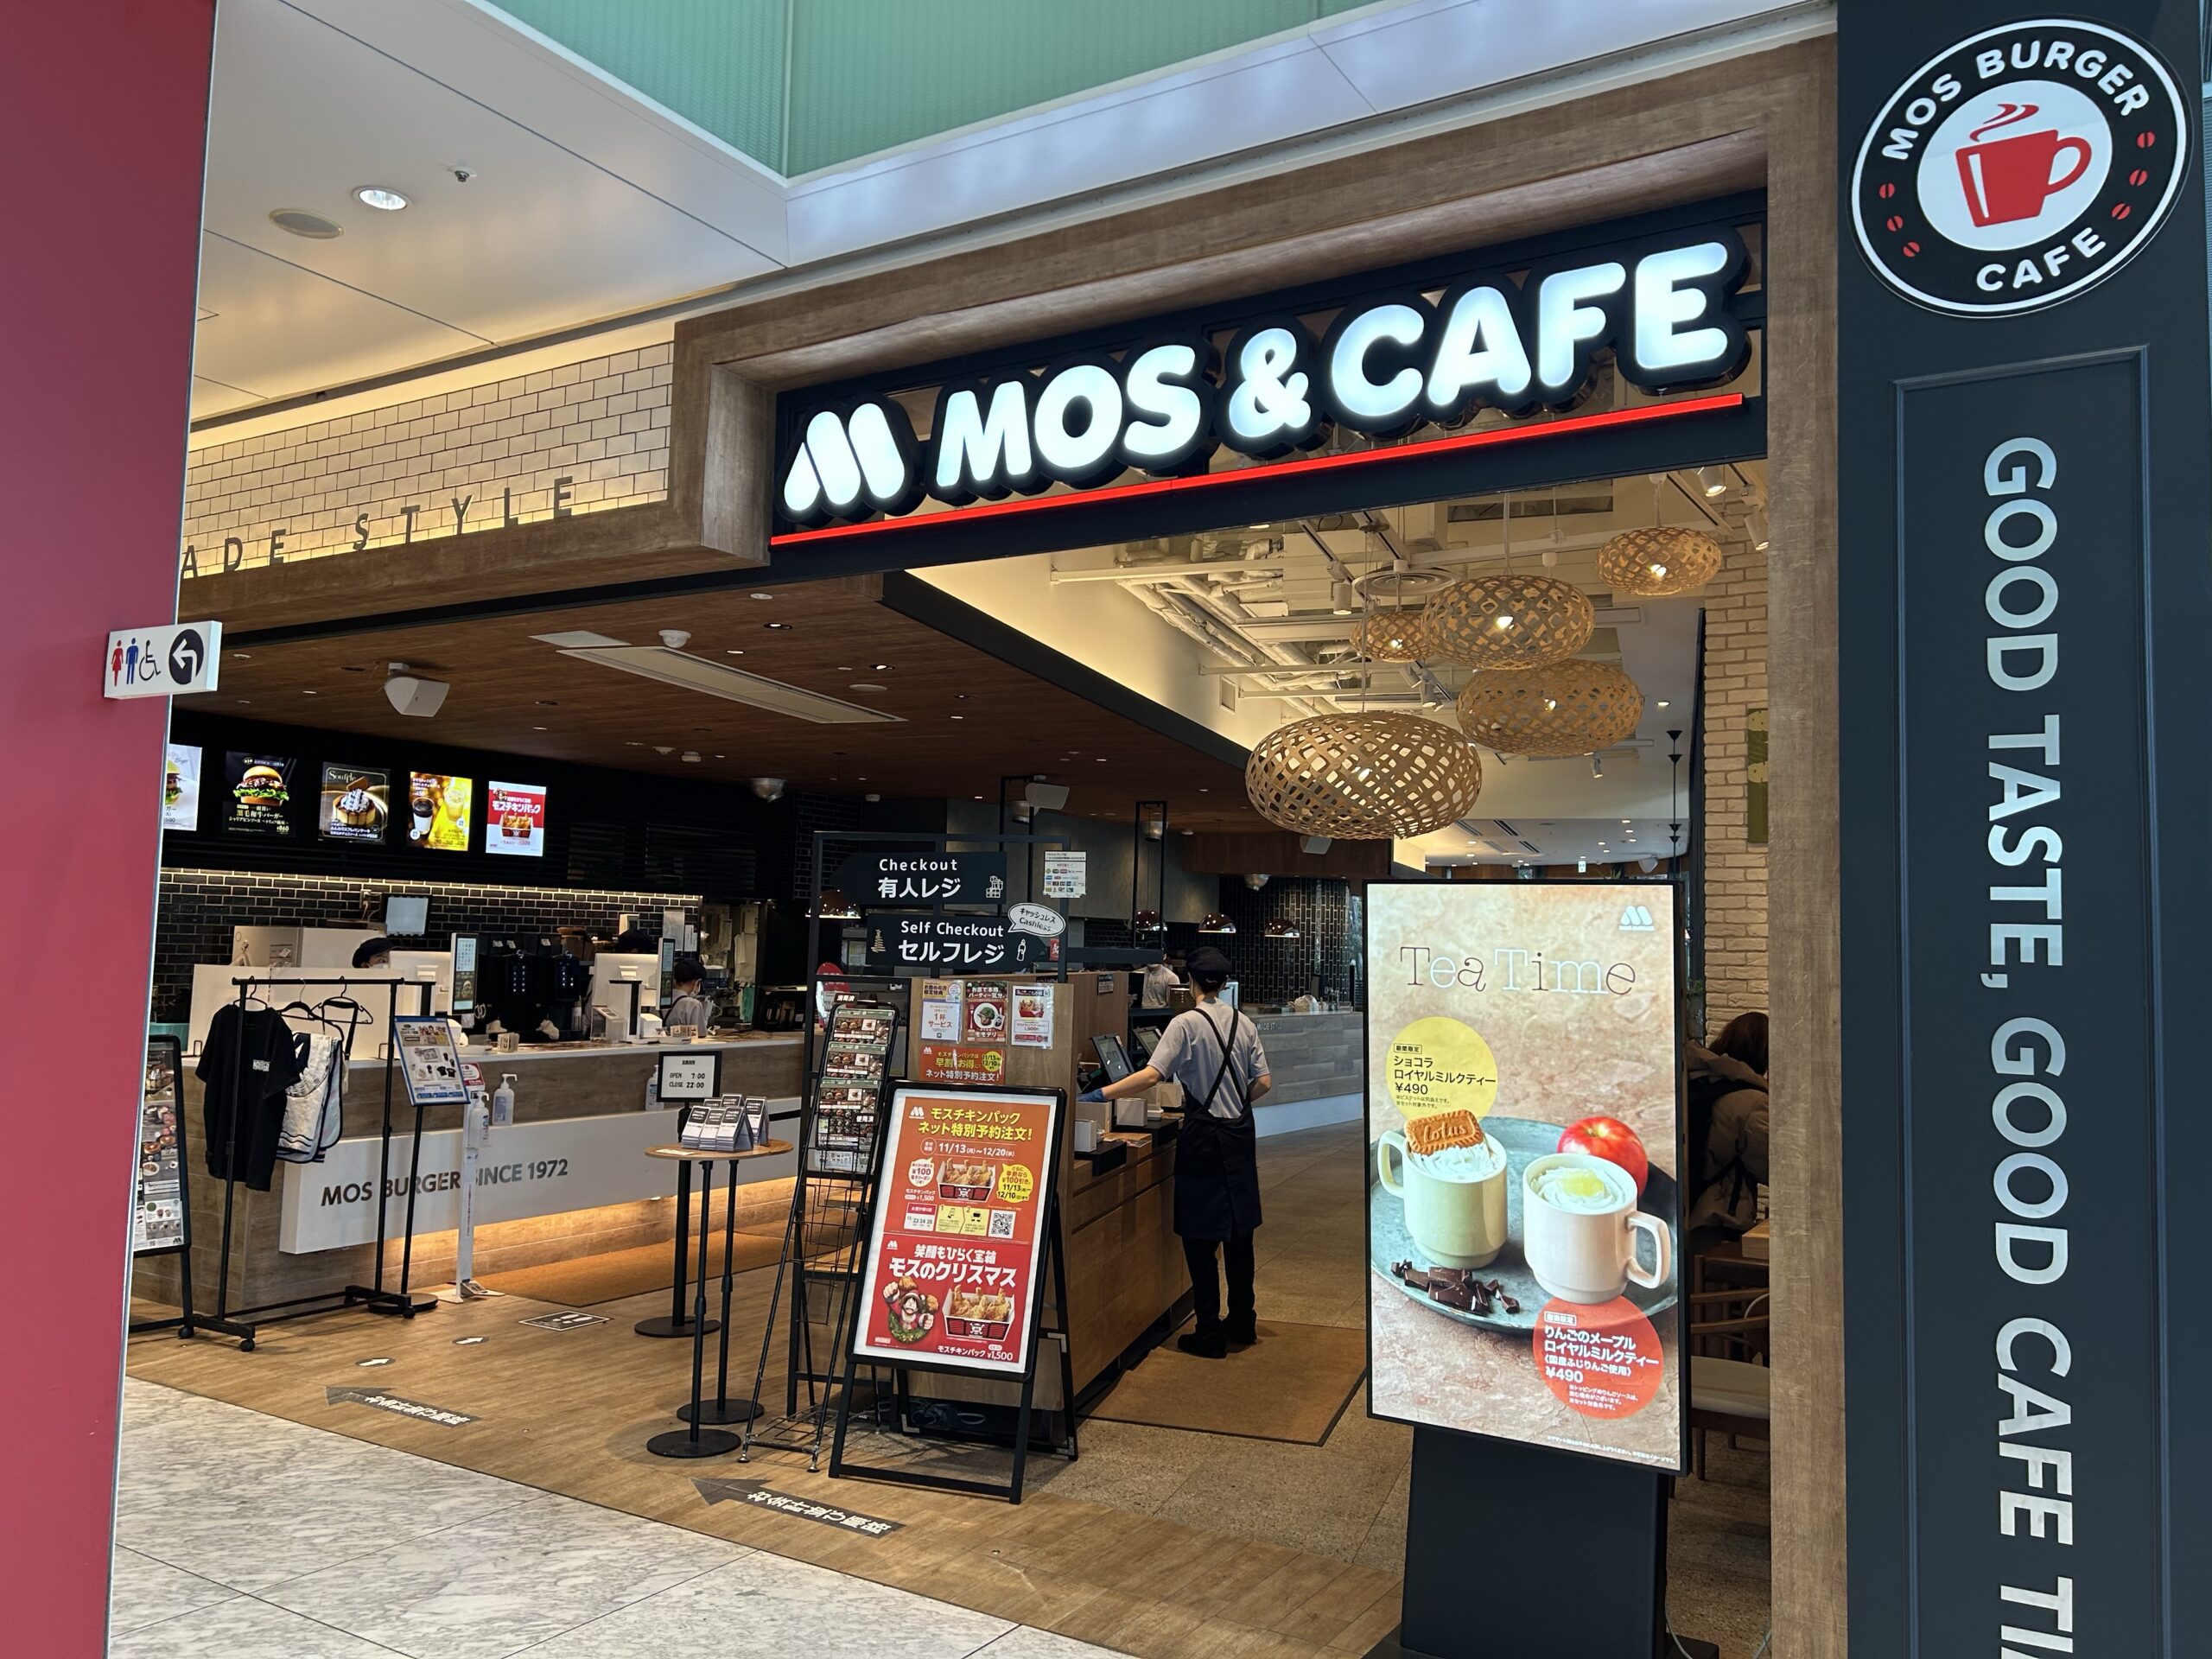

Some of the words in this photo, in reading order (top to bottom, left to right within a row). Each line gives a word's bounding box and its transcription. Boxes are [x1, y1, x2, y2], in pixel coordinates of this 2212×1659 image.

[1882, 73, 1962, 161] MOS
[1975, 40, 2151, 117] BURGER
[1976, 226, 2107, 292] CAFE
[935, 342, 1202, 489] MOS
[1227, 327, 1313, 440] &
[1331, 240, 1729, 417] CAFE
[352, 475, 574, 551] STYLE
[1983, 436, 2059, 691] GOOD
[1980, 714, 2063, 989] TASTE,
[879, 858, 958, 872] Checkout
[877, 877, 962, 899] 有人レジ
[1019, 906, 1057, 924] キャッシュレス
[1019, 916, 1052, 933] Cashless
[900, 920, 931, 935] Self
[936, 922, 1004, 938] Checkout
[898, 938, 1005, 965] セルフレジ
[1399, 945, 1487, 993] Tea
[1494, 948, 1637, 995] Time
[1394, 1055, 1433, 1068] ショコラ
[1394, 1069, 1497, 1086] ロイヤルミルクティー
[1395, 1082, 1428, 1095] ¥490
[931, 1107, 1021, 1123] モスチキンパック
[918, 1122, 1033, 1141] ネット特別予約注文!
[1990, 1016, 2069, 1285] GOOD
[321, 1181, 372, 1207] MOS
[475, 1163, 522, 1187] INCE
[527, 1158, 569, 1179] 1972
[913, 1243, 997, 1265] 笑顔もひらく宝箱
[888, 1256, 1018, 1288] モスのクリスマス
[1544, 1325, 1637, 1351] りんごのメープル
[938, 1345, 986, 1358] モスチキンパック
[987, 1351, 1014, 1362] ¥1,500
[1544, 1339, 1660, 1368] ロイヤルミルクティー
[1545, 1365, 1584, 1383] ¥490
[1995, 1316, 2074, 1546] CAFE
[1999, 1575, 2074, 1659] TI
